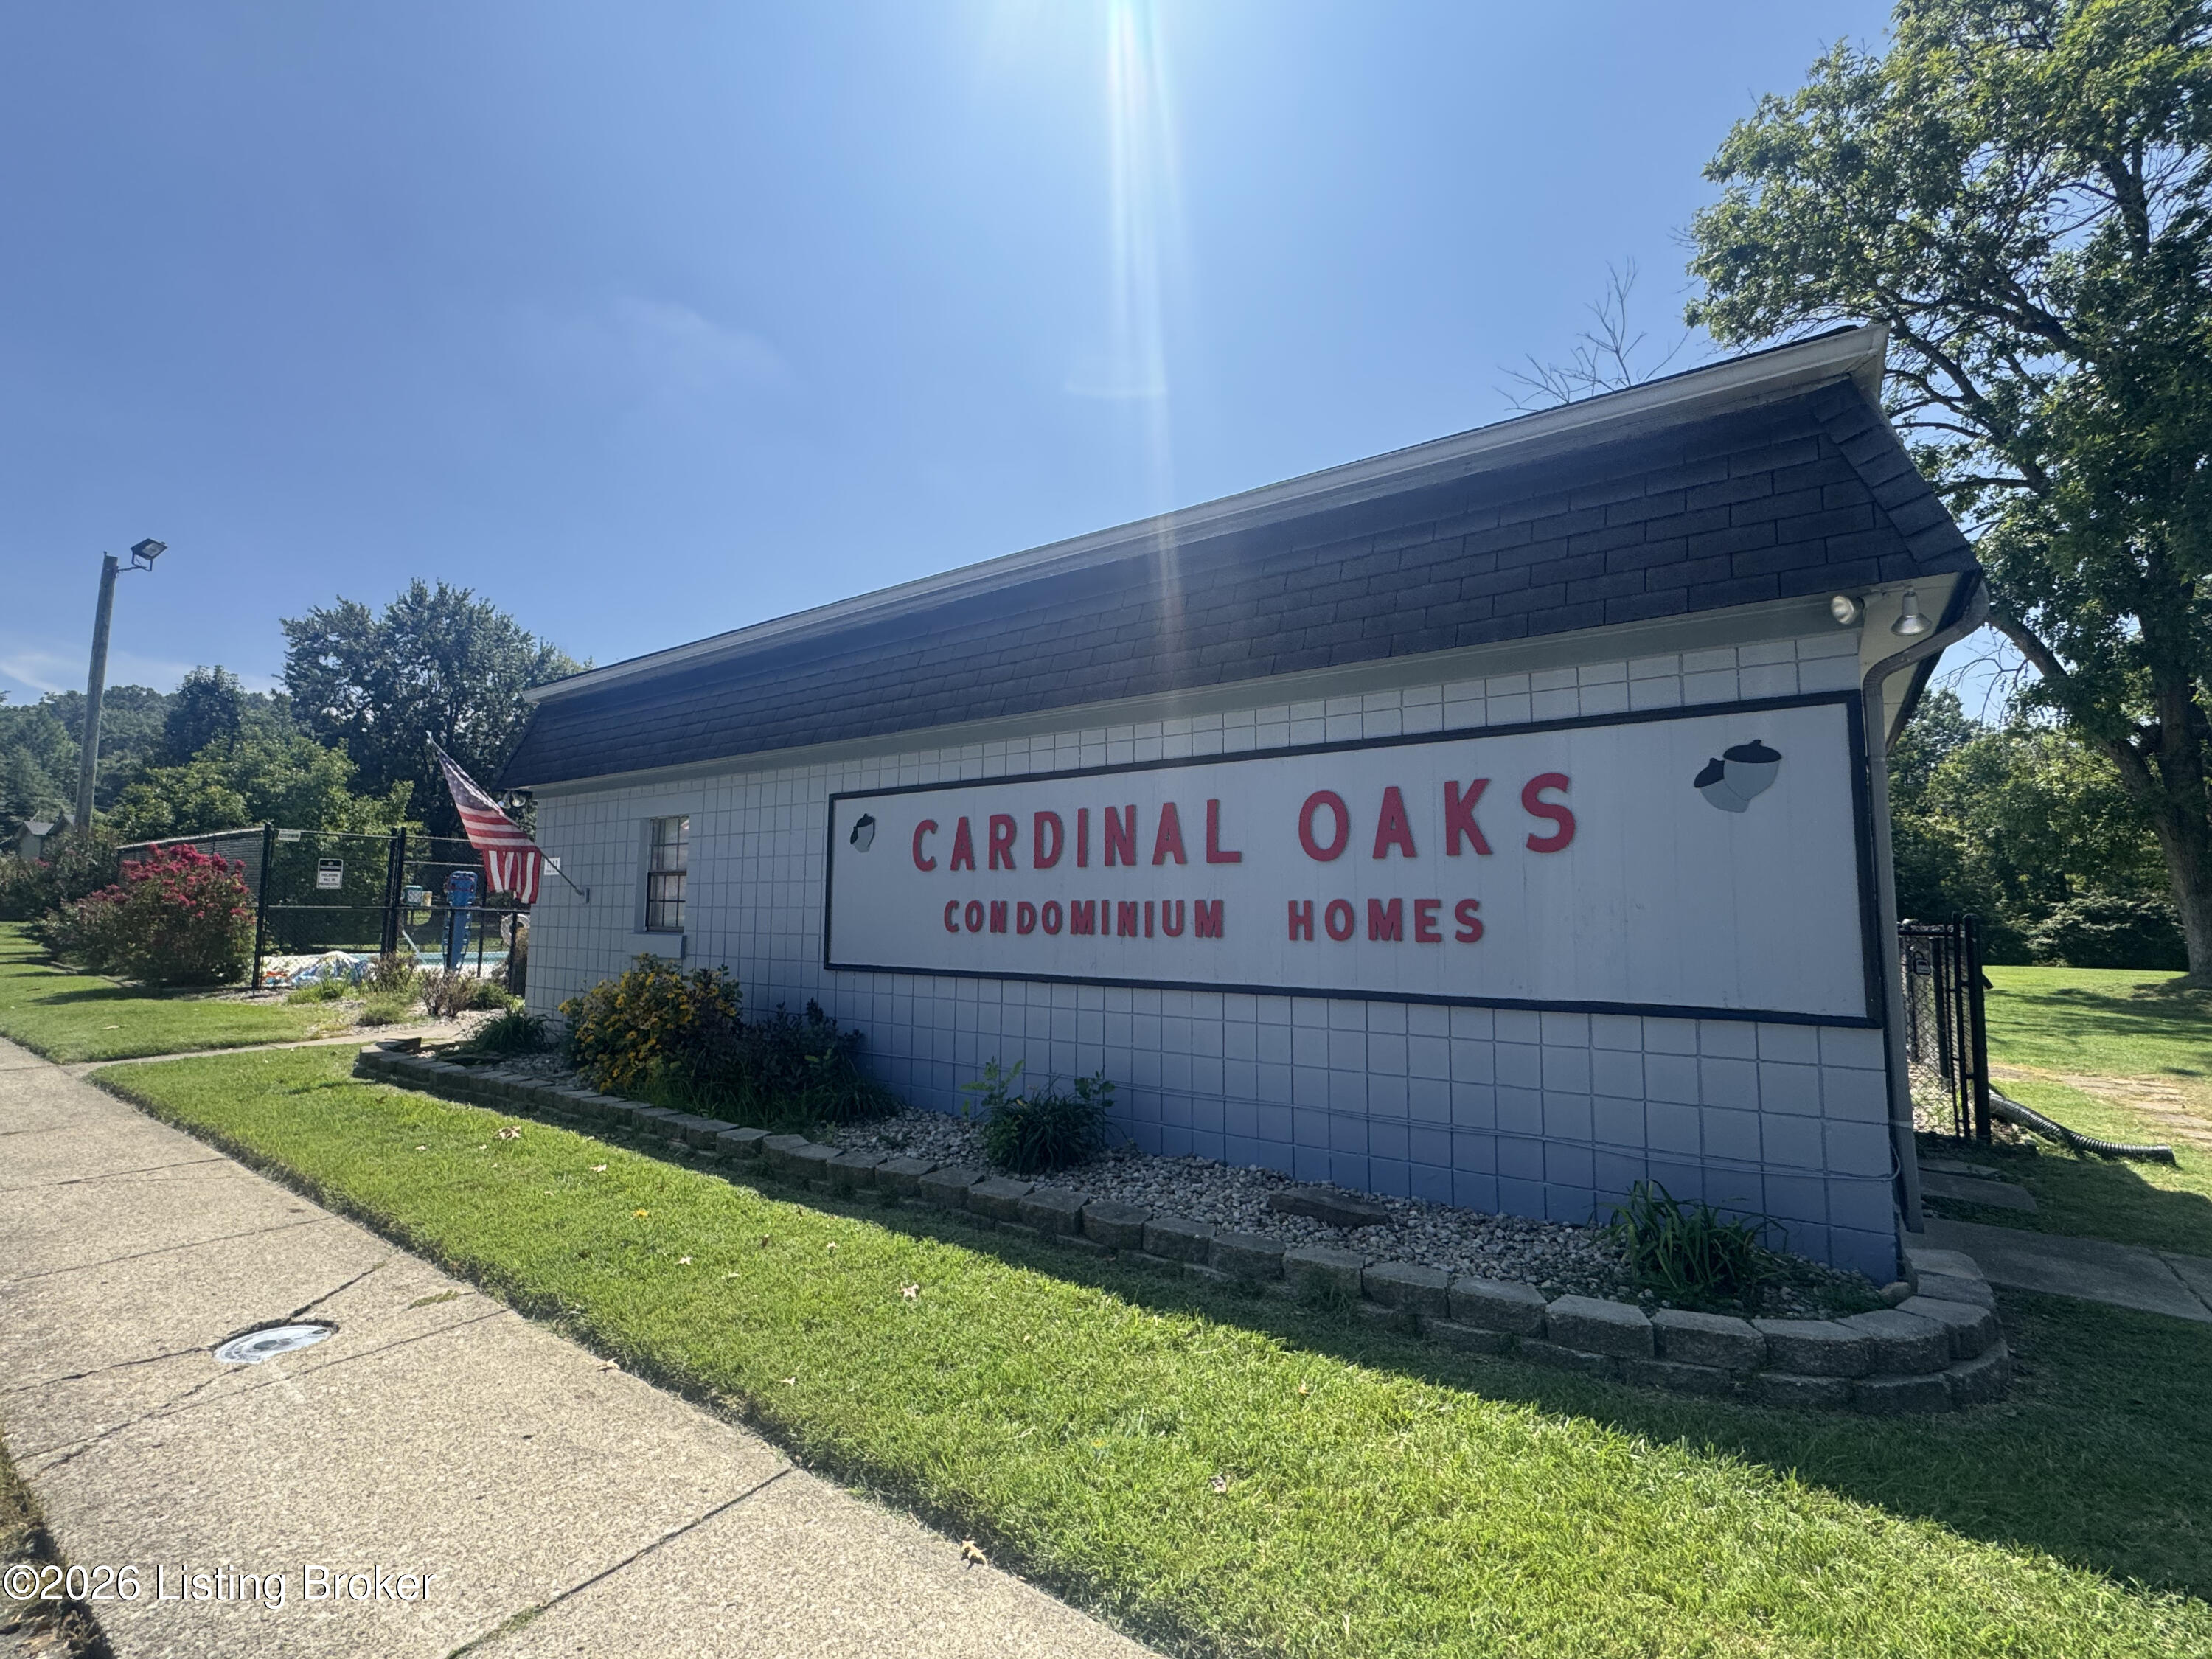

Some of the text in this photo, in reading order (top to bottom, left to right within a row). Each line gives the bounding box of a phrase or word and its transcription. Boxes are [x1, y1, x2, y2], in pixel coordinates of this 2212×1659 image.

[912, 772, 1576, 872] CARDINAL OAKS
[944, 898, 1484, 943] CONDOMINIUM HOMES
